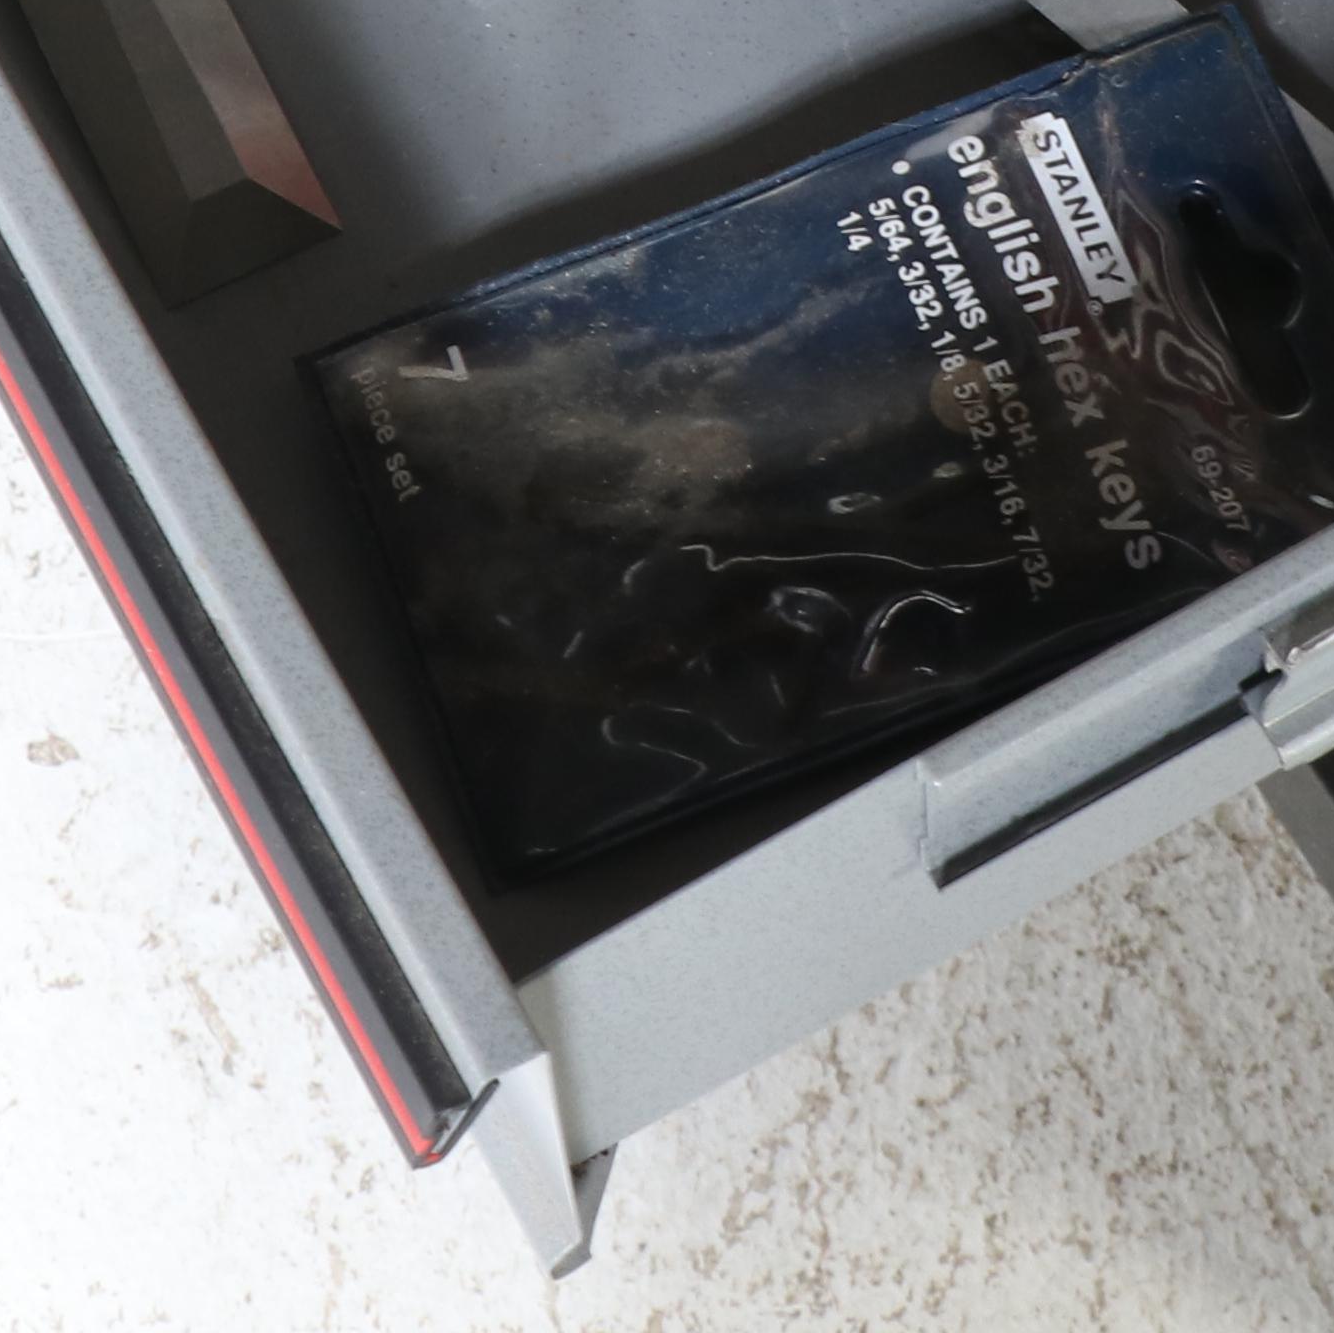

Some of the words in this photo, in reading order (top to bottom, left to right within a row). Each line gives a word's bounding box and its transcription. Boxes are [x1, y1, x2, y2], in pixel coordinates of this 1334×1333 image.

[835, 211, 873, 252] 1/4
[902, 183, 988, 331] CONTAINS
[1032, 129, 1125, 286] STANLEY
[868, 199, 911, 262] 5/64,
[898, 266, 944, 331] 3/32,
[930, 332, 967, 381] 1/8,
[953, 383, 997, 451] 5/32,
[983, 453, 1027, 525] 3/16,
[1012, 530, 1055, 602] 7/32,
[947, 134, 1057, 314] english
[1039, 325, 1104, 428] hex
[1085, 439, 1163, 570] keys
[972, 337, 998, 353] 1
[982, 357, 1037, 455] EACH:
[350, 365, 396, 445] piece
[386, 451, 422, 503] set
[1190, 445, 1252, 532] 69-207
